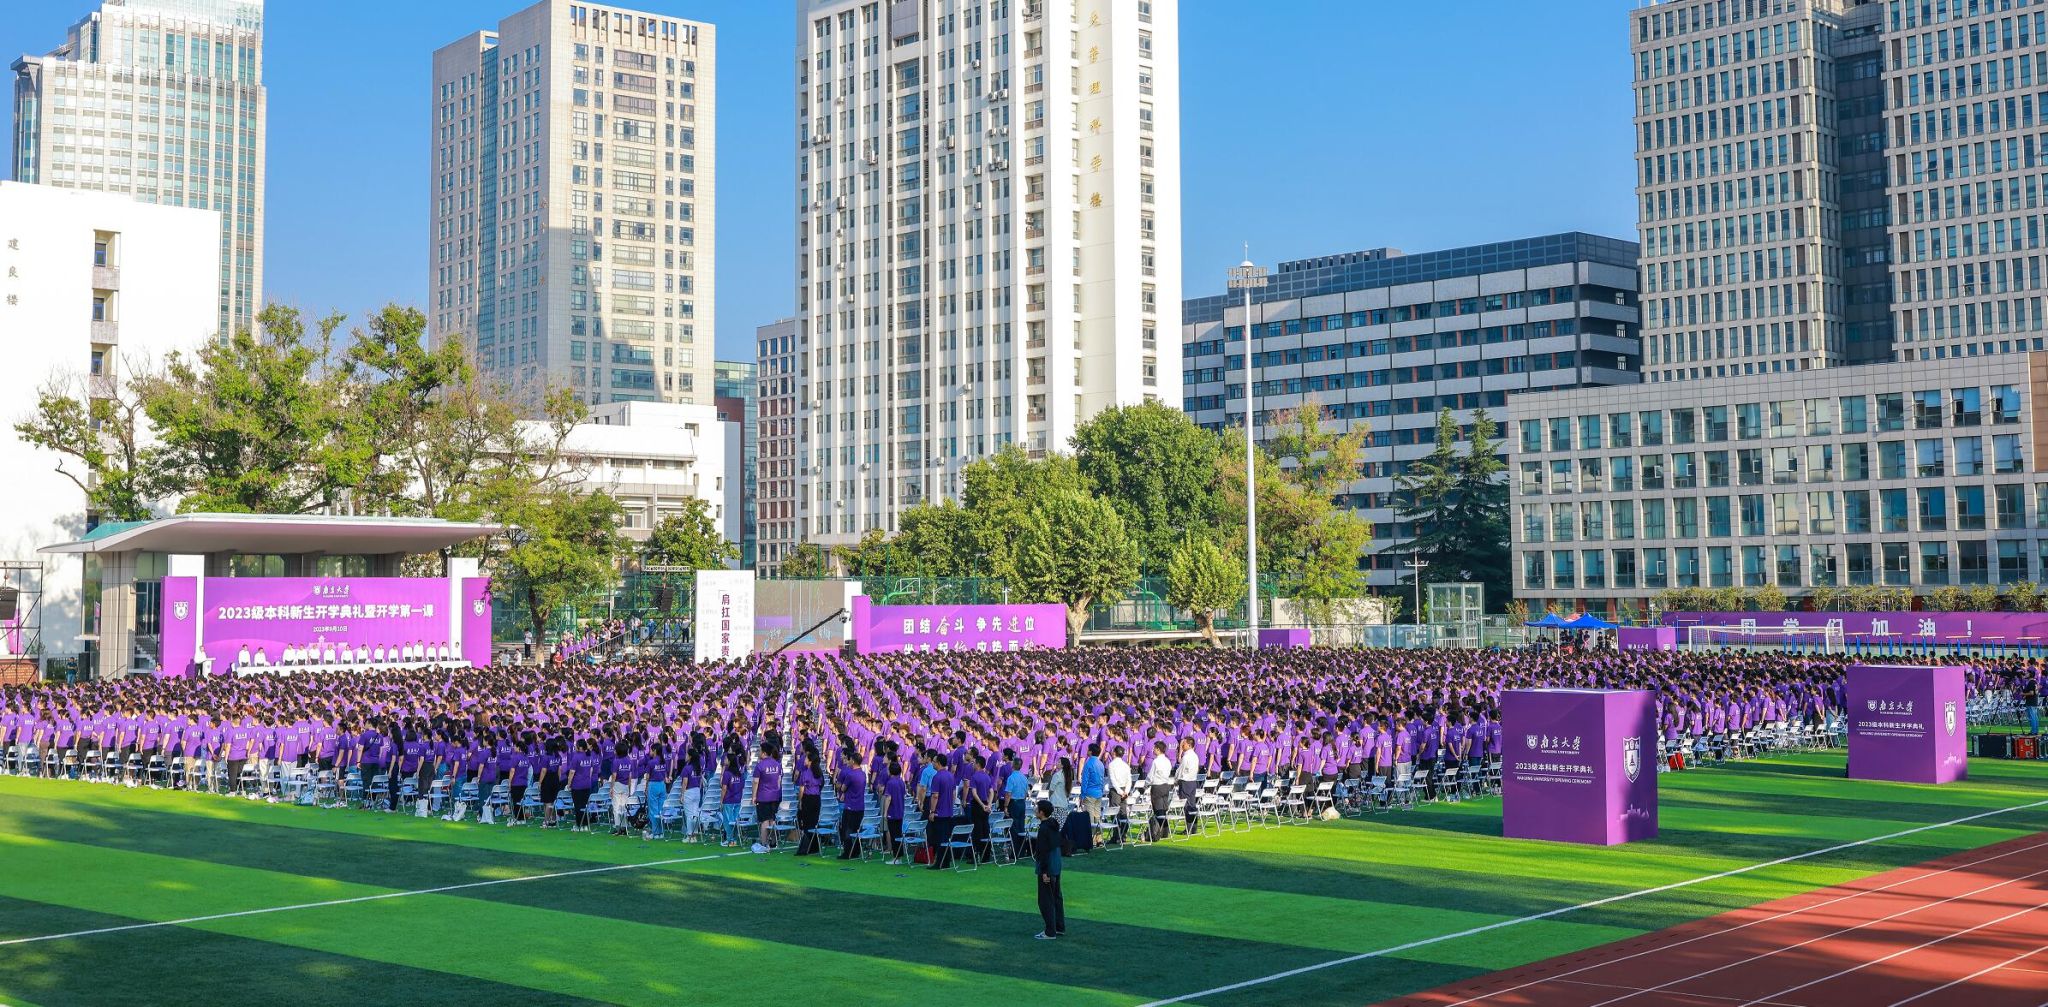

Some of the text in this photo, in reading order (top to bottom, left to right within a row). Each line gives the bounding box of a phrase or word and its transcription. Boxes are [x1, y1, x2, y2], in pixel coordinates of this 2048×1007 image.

[218, 604, 434, 620] 2023级本科新生开学典礼暨开学第一课
[721, 594, 730, 657] 肩扛国家责
[1858, 721, 1925, 730] 2023级本科新生开学典礼
[1515, 762, 1594, 774] 2023级本科新生开学典礼
